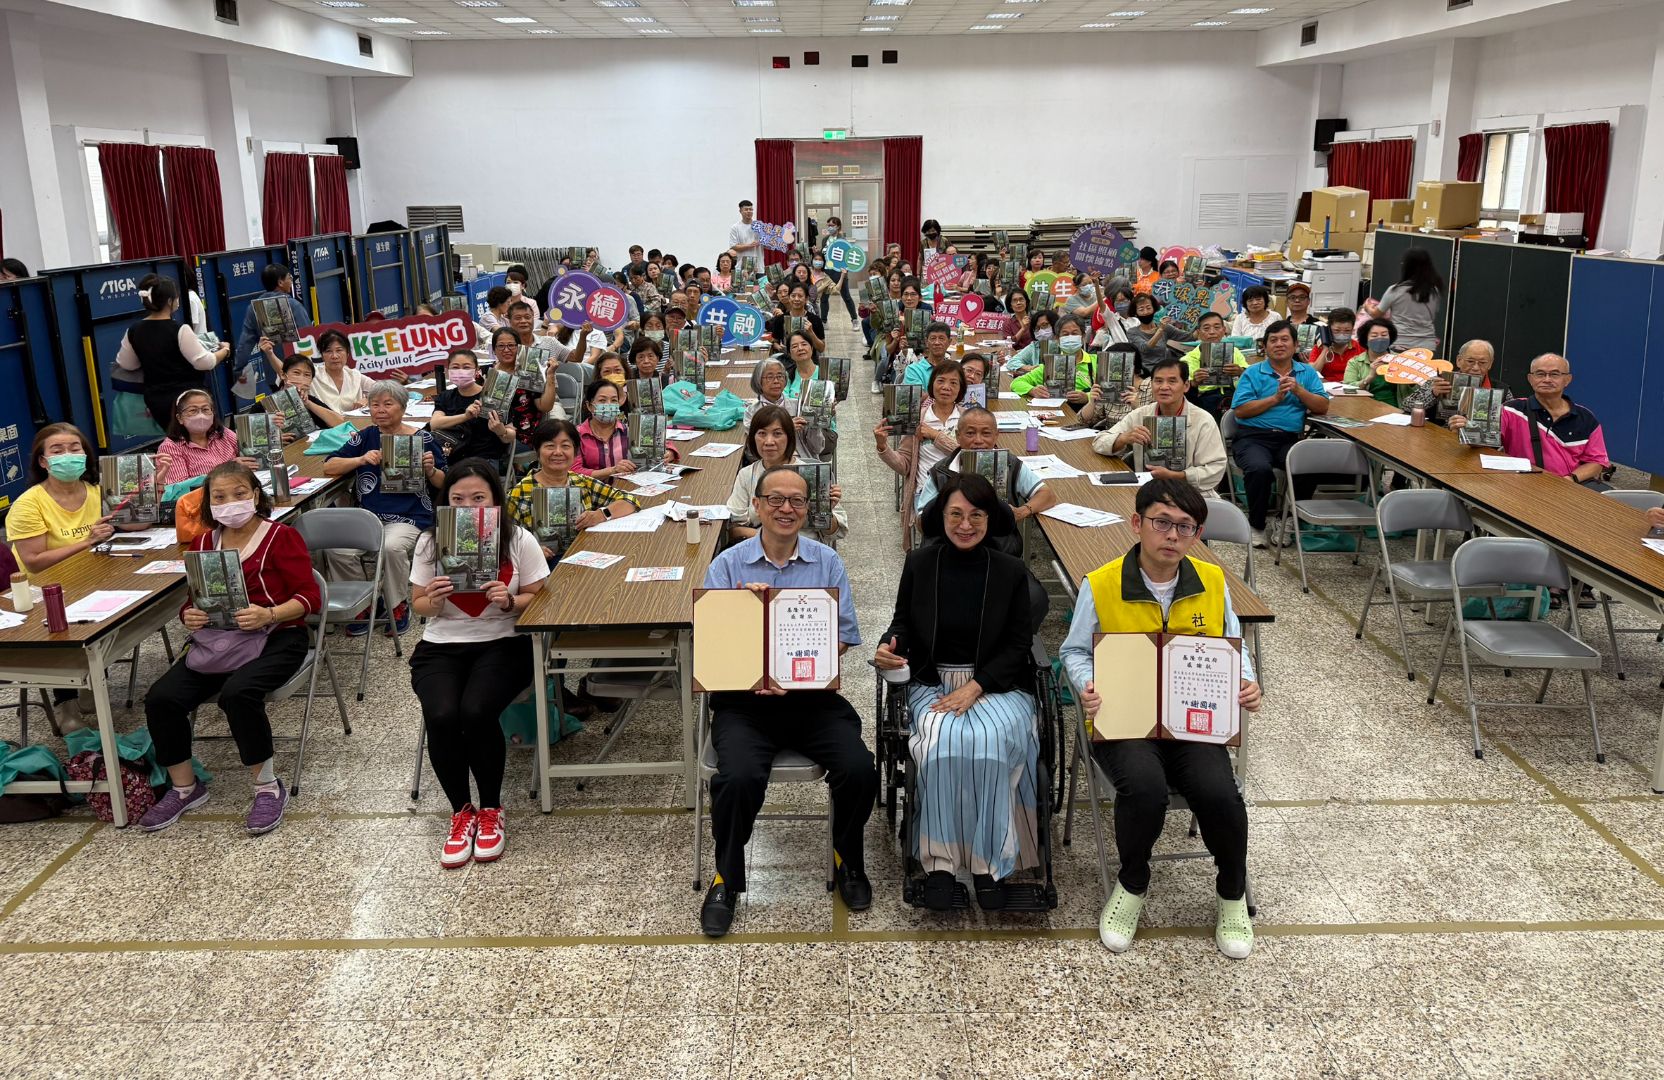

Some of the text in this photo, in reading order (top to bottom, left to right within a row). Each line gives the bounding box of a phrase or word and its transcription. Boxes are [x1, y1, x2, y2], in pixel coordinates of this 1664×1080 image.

[1070, 221, 1113, 243] KEELUNG
[831, 246, 861, 266] 自主
[1078, 241, 1118, 258] 社區照顧
[1074, 251, 1114, 268] 關懷據點
[232, 260, 255, 277] 強生牌
[100, 278, 136, 295] STIGA
[1031, 280, 1073, 298] 共生
[557, 282, 620, 321] 永續
[938, 303, 960, 315] 有愛
[705, 307, 756, 336] 共融
[350, 321, 465, 358] KEELUNG
[358, 354, 413, 371] A city full of
[60, 527, 70, 536] la
[1182, 654, 1218, 663] 基隆市政府
